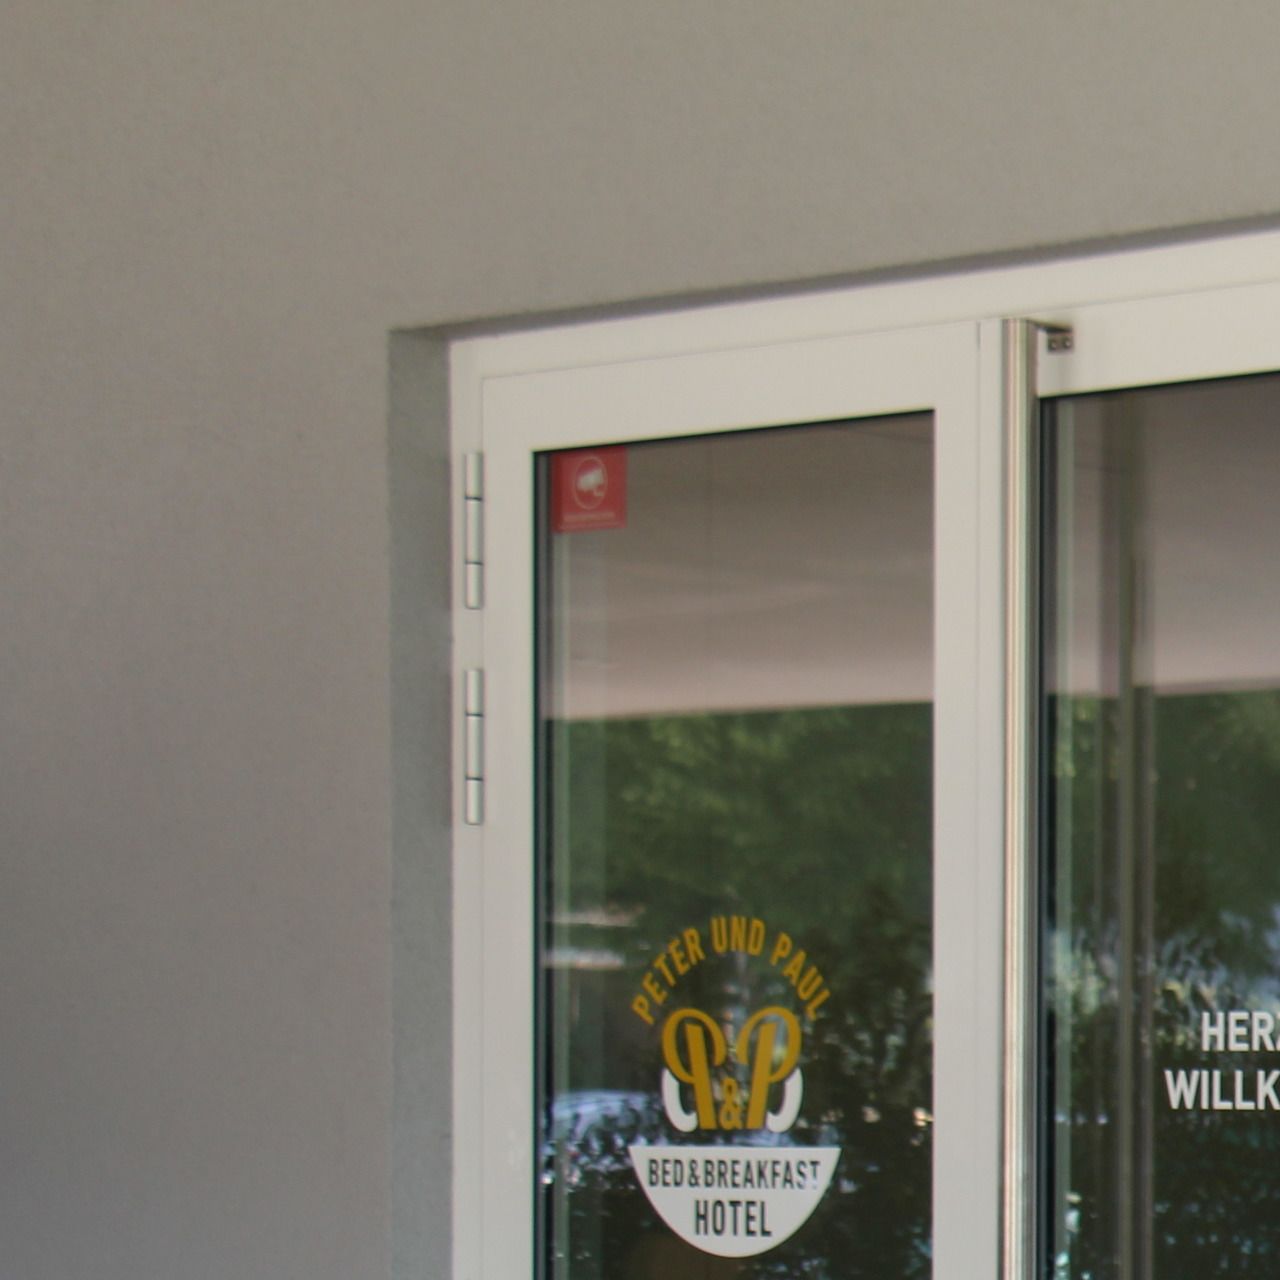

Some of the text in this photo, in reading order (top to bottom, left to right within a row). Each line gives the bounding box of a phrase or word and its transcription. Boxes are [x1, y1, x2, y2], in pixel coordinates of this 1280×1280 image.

[632, 915, 831, 1024] PETER UND PAUL
[695, 1199, 772, 1238] HOTEL
